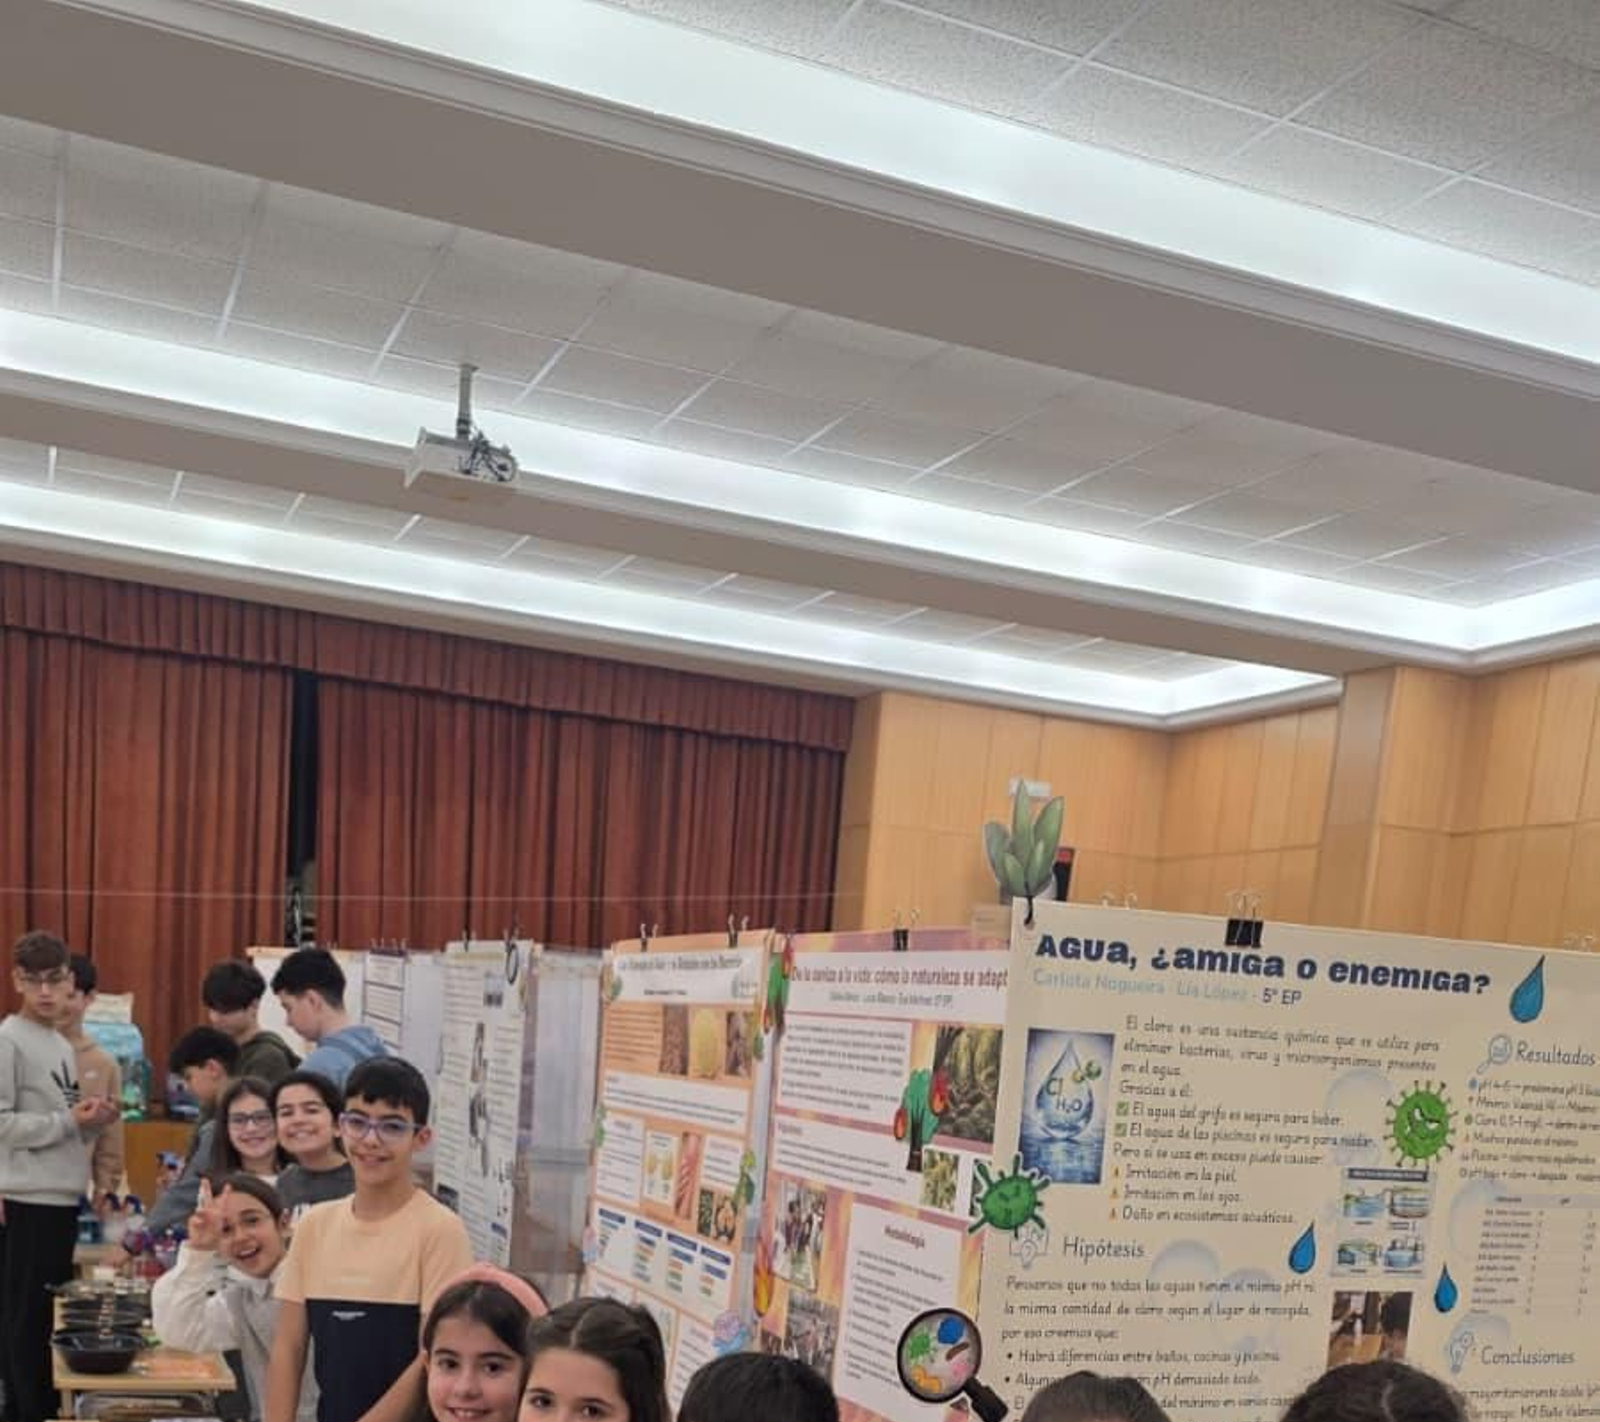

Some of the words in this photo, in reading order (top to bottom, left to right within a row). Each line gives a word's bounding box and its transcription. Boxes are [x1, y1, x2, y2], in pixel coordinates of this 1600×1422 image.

[911, 968, 960, 986] naturaleza
[963, 971, 974, 986] se
[1296, 959, 1317, 980] o
[1281, 990, 1301, 1005] EP
[1126, 1015, 1138, 1030] El
[1144, 1018, 1174, 1033] cloro
[1180, 1024, 1192, 1034] es
[1198, 1025, 1220, 1036] una
[1225, 1026, 1279, 1040] sustancia
[1284, 1030, 1330, 1048] química
[1336, 1035, 1356, 1050] que
[1414, 1039, 1440, 1054] para
[1124, 1039, 1175, 1055] eliminar
[1180, 1044, 1234, 1060] bacterias,
[1240, 1049, 1268, 1061] virus
[1274, 1053, 1280, 1066] y
[1387, 1058, 1436, 1073] presentes
[1517, 1040, 1595, 1066] Resultados
[1122, 1064, 1135, 1074] en
[1139, 1060, 1148, 1074] el
[1121, 1079, 1165, 1097] Gracias
[1169, 1087, 1176, 1097] a
[1132, 1102, 1144, 1116] El
[1147, 1107, 1175, 1121] agua
[1179, 1106, 1196, 1118] del
[1198, 1108, 1226, 1125] grifo
[1229, 1111, 1241, 1120] es
[1283, 1112, 1309, 1125] para
[1130, 1123, 1141, 1136] El
[1144, 1128, 1173, 1143] agua
[1177, 1126, 1190, 1140] de
[1194, 1127, 1209, 1140] las
[1212, 1129, 1256, 1144] piscinas
[1260, 1134, 1269, 1143] es
[1313, 1135, 1338, 1149] para
[1114, 1143, 1139, 1157] Pero
[1144, 1146, 1152, 1158] si
[1157, 1150, 1168, 1159] se
[1171, 1151, 1189, 1161] usa
[1194, 1153, 1208, 1161] en
[1212, 1153, 1246, 1163] exceso
[1249, 1153, 1282, 1167] puede
[1124, 1164, 1181, 1180] Irritación
[1184, 1171, 1198, 1181] en
[1201, 1168, 1212, 1180] la
[1124, 1184, 1180, 1200] Irritación
[1182, 1191, 1196, 1201] en
[1199, 1189, 1215, 1202] los
[1122, 1206, 1154, 1221] Daño
[1160, 1212, 1171, 1221] en
[1174, 1210, 1238, 1223] ecosistemas
[1062, 1237, 1145, 1264] Hipótesis
[1006, 1275, 1063, 1292] Pensamos
[1067, 1281, 1086, 1294] que
[1091, 1281, 1106, 1291] no
[1111, 1279, 1141, 1292] todas
[1145, 1279, 1161, 1292] las
[1163, 1281, 1195, 1295] aguas
[1199, 1280, 1230, 1292] tienen
[1234, 1279, 1243, 1292] el
[1247, 1280, 1281, 1293] mismo
[1284, 1281, 1301, 1296] pH
[1004, 1303, 1014, 1315] la
[1019, 1304, 1056, 1315] misma
[1062, 1301, 1111, 1316] cantidad
[1117, 1303, 1129, 1316] de
[1135, 1303, 1163, 1316] cloro
[1203, 1303, 1211, 1316] el
[1217, 1303, 1244, 1320] lugar
[1249, 1304, 1261, 1316] de
[1002, 1328, 1020, 1340] por
[1024, 1328, 1042, 1338] eso
[1044, 1327, 1092, 1338] creemos
[1094, 1327, 1118, 1342] que:
[1019, 1349, 1053, 1363] Habrá
[1057, 1348, 1119, 1366] diferencias
[1123, 1350, 1152, 1362] entre
[1194, 1350, 1231, 1363] cocinas
[1234, 1352, 1241, 1366] y
[1480, 1345, 1575, 1365] Conclusiones
[1153, 1374, 1170, 1388] pH
[1174, 1372, 1229, 1386] demasiado
[1223, 1398, 1236, 1407] en
